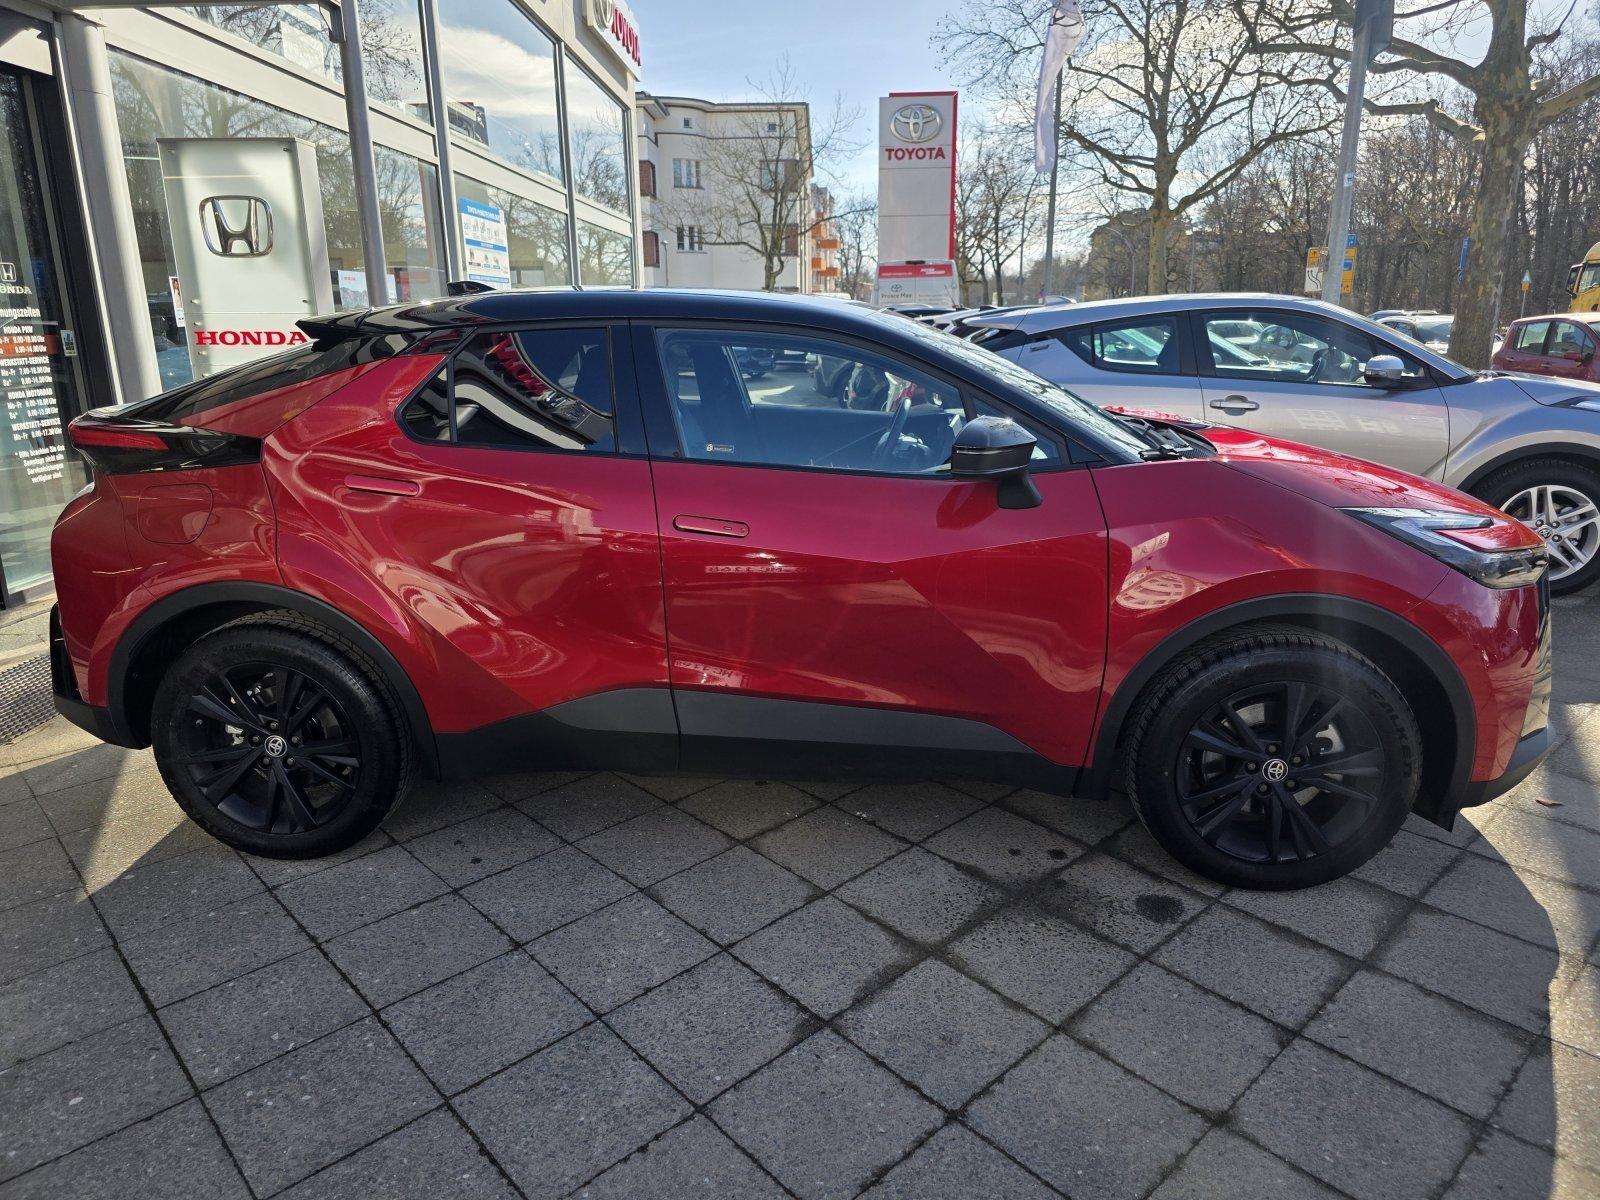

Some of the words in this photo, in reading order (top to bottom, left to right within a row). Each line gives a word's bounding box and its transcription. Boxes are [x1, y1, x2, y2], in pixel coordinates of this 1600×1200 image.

[611, 8, 641, 66] TOYOTA
[885, 147, 945, 160] TOYOTA
[3, 326, 22, 334] HONDA
[22, 325, 33, 333] PKW
[195, 331, 307, 345] HONDA
